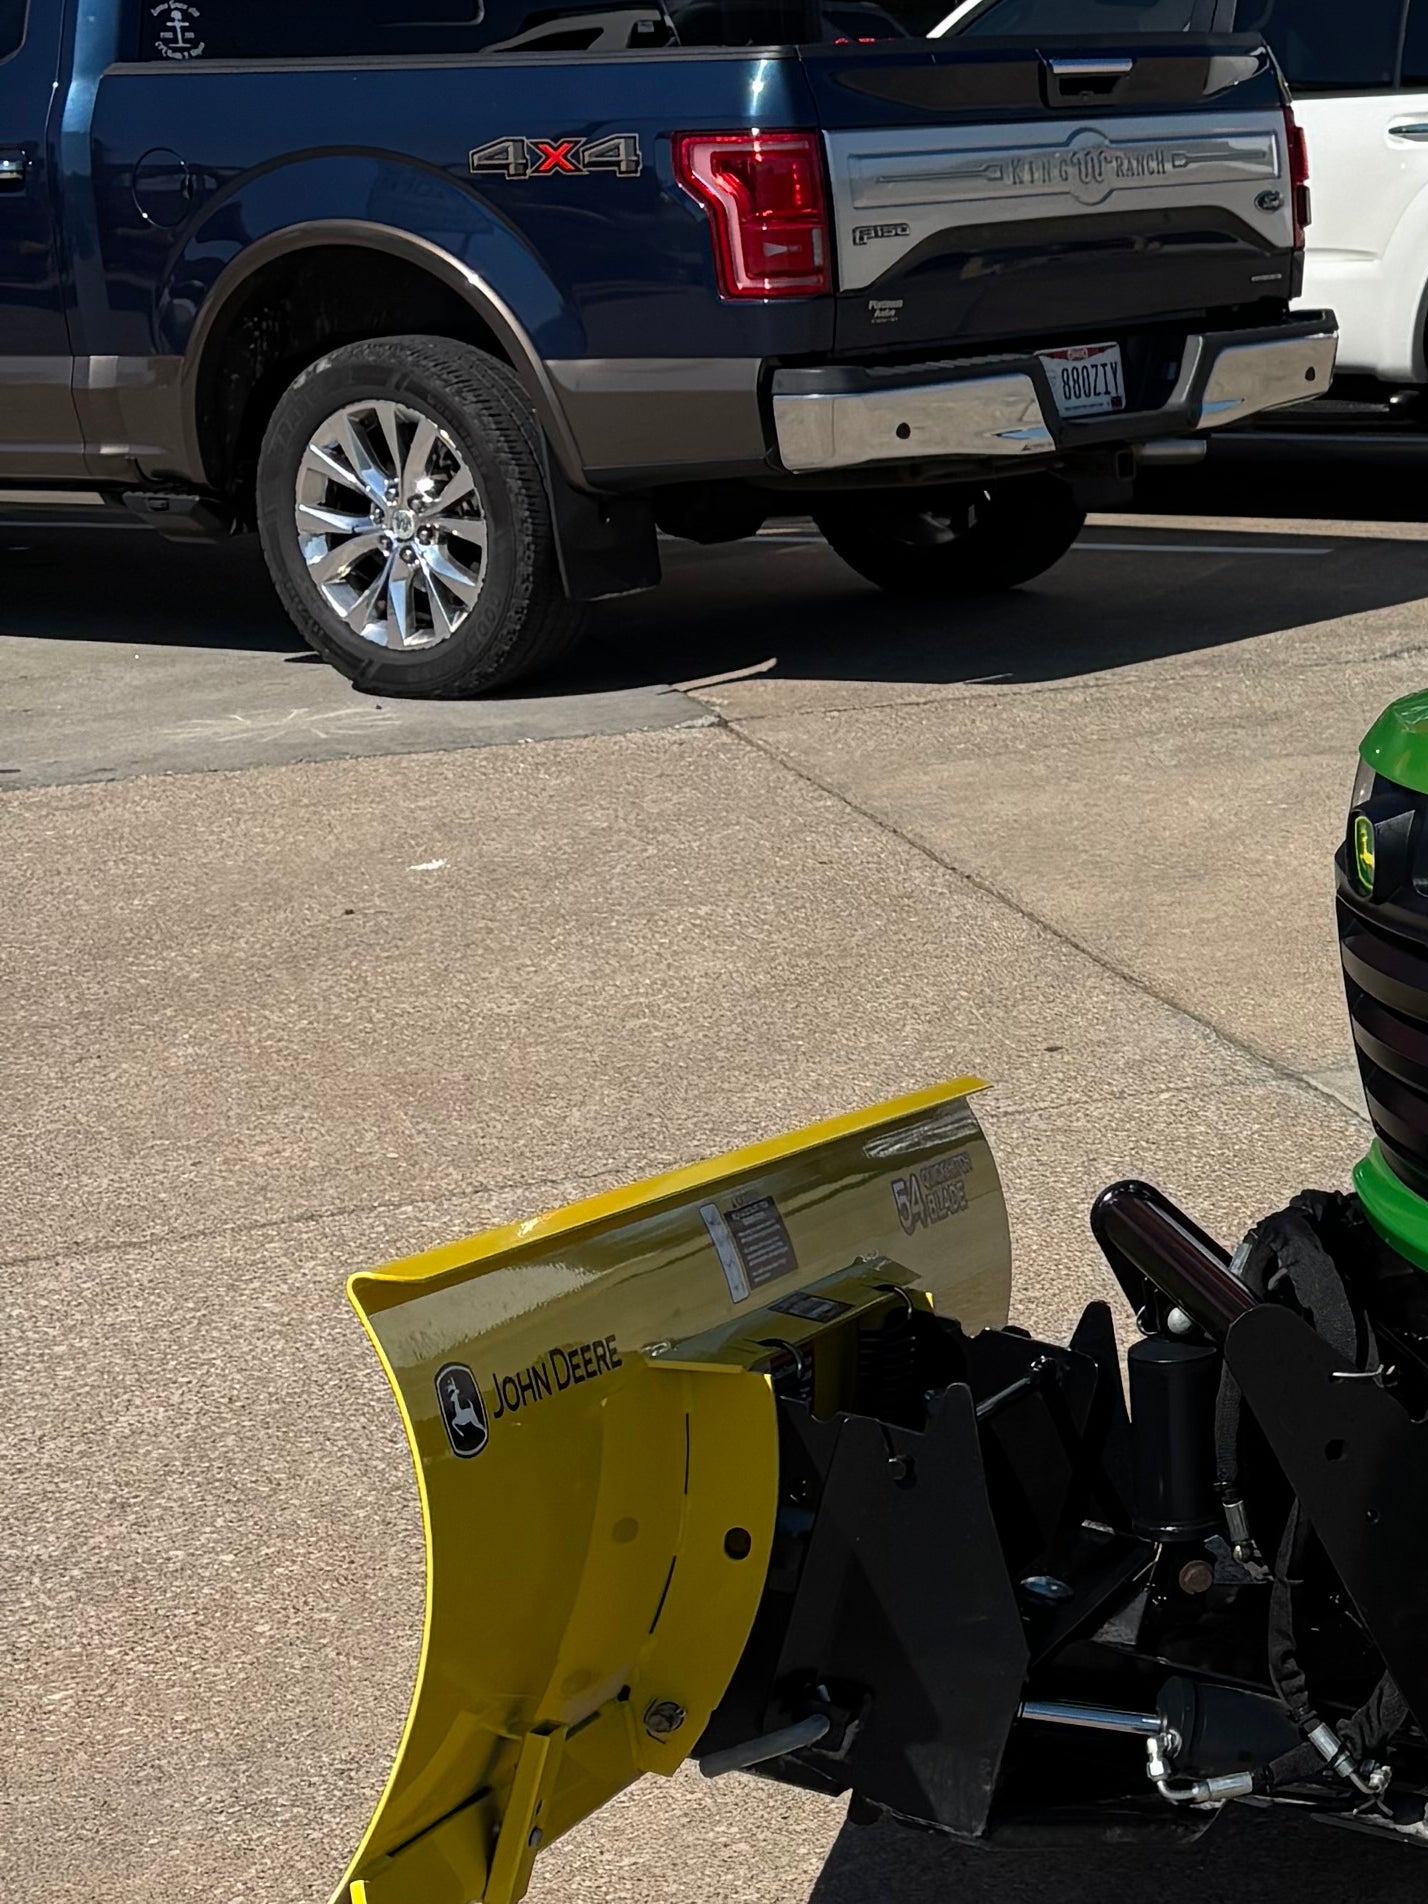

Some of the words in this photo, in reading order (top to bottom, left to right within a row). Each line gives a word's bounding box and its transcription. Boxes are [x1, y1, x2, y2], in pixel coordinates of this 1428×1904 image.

[1011, 157, 1070, 185] KING
[1115, 149, 1167, 178] RANCH
[926, 1180, 969, 1225] BLADE
[492, 1361, 553, 1419] JOHN
[548, 1334, 623, 1392] DEERE
